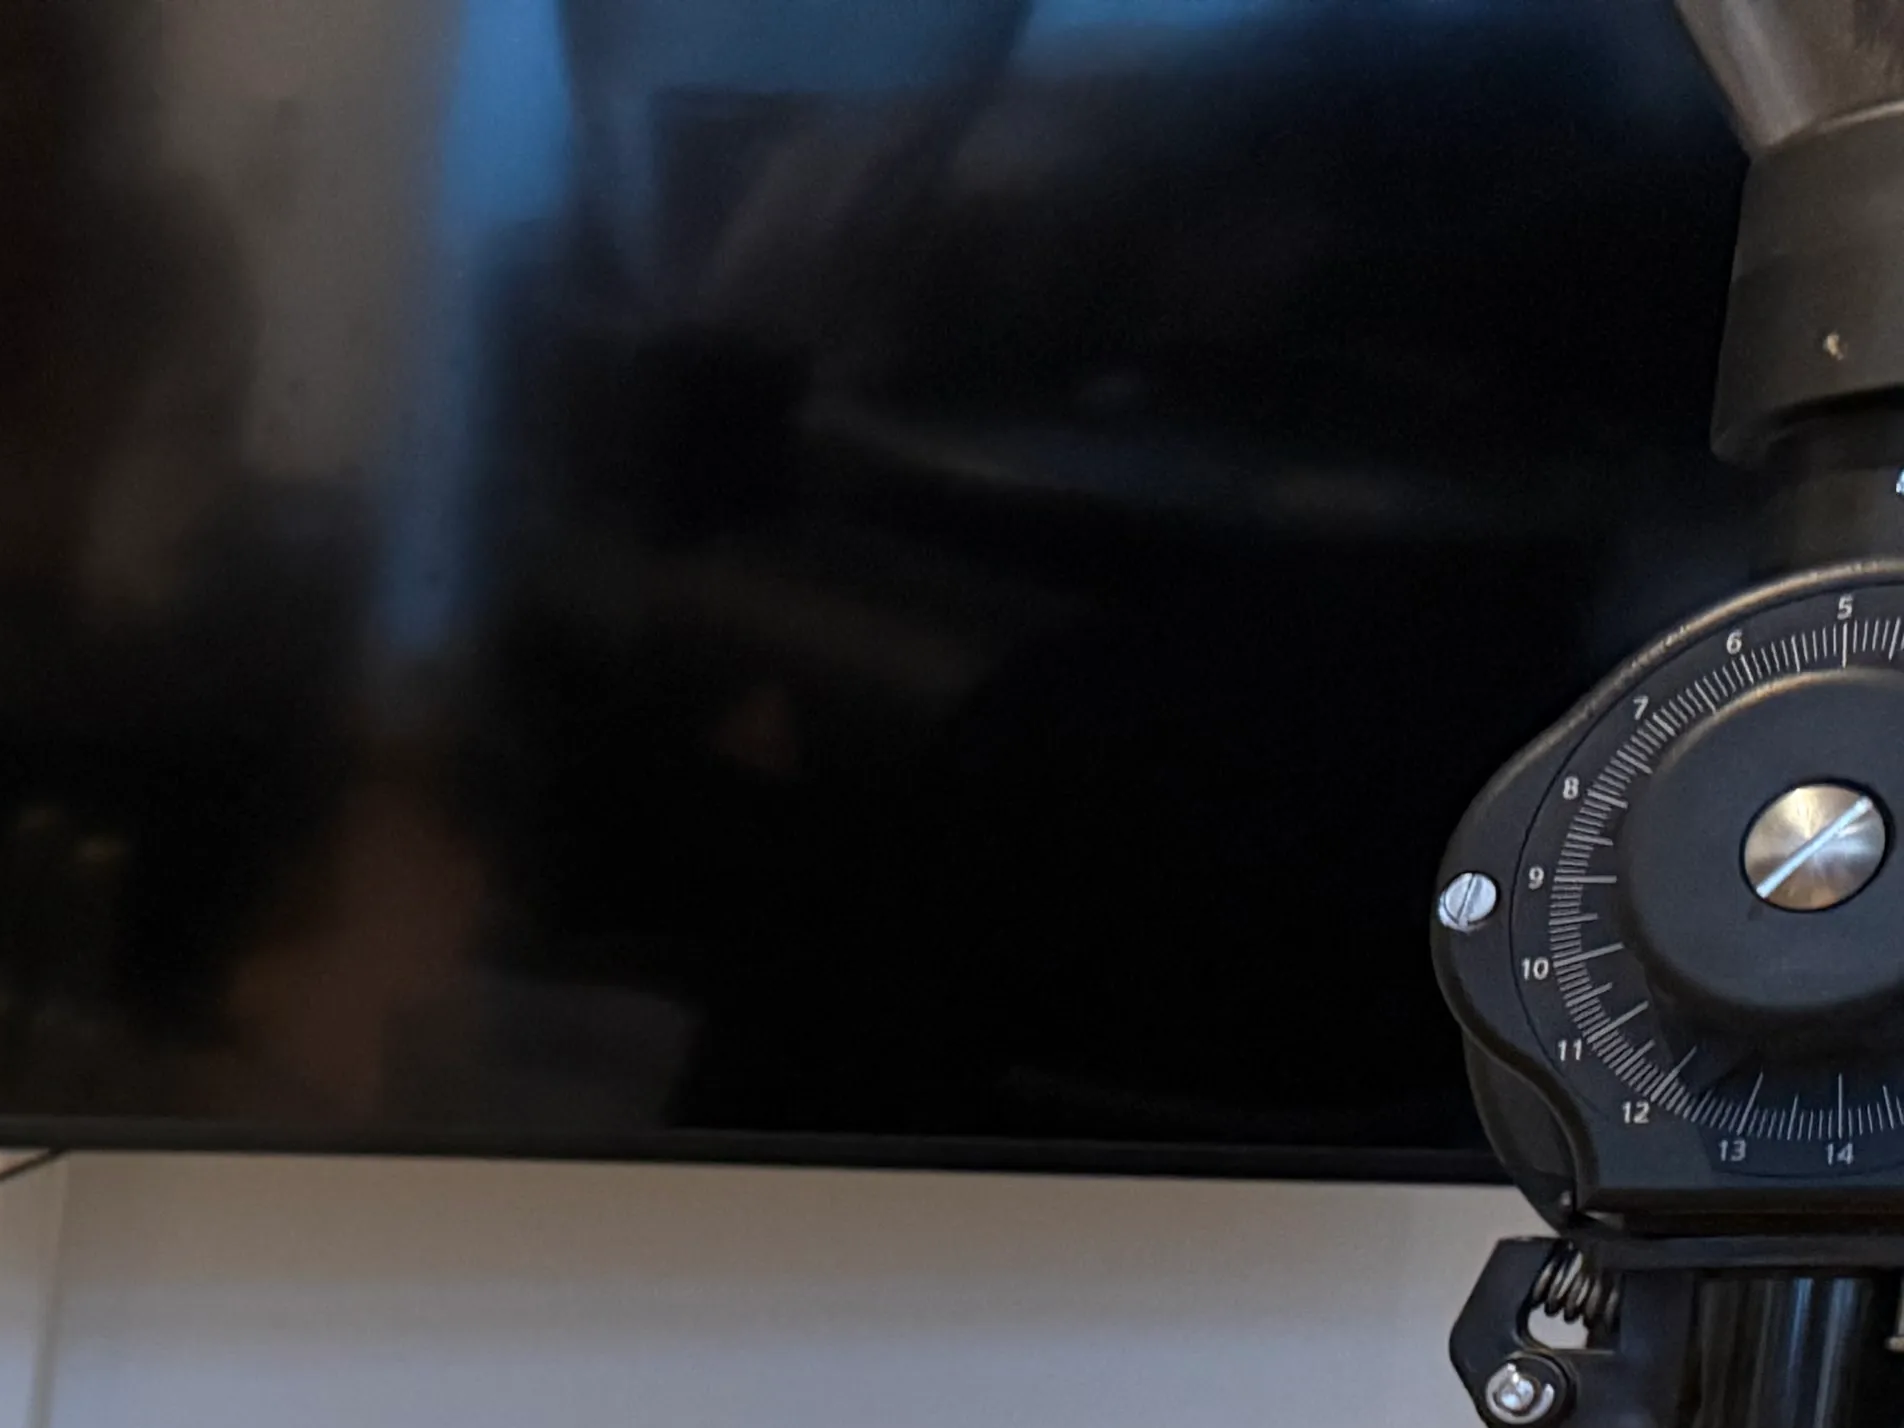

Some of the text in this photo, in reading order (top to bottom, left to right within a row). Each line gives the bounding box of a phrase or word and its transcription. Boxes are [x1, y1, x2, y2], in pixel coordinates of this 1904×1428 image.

[1521, 596, 1854, 1165] 5 6 7 8 9 10 11 12 13 14
